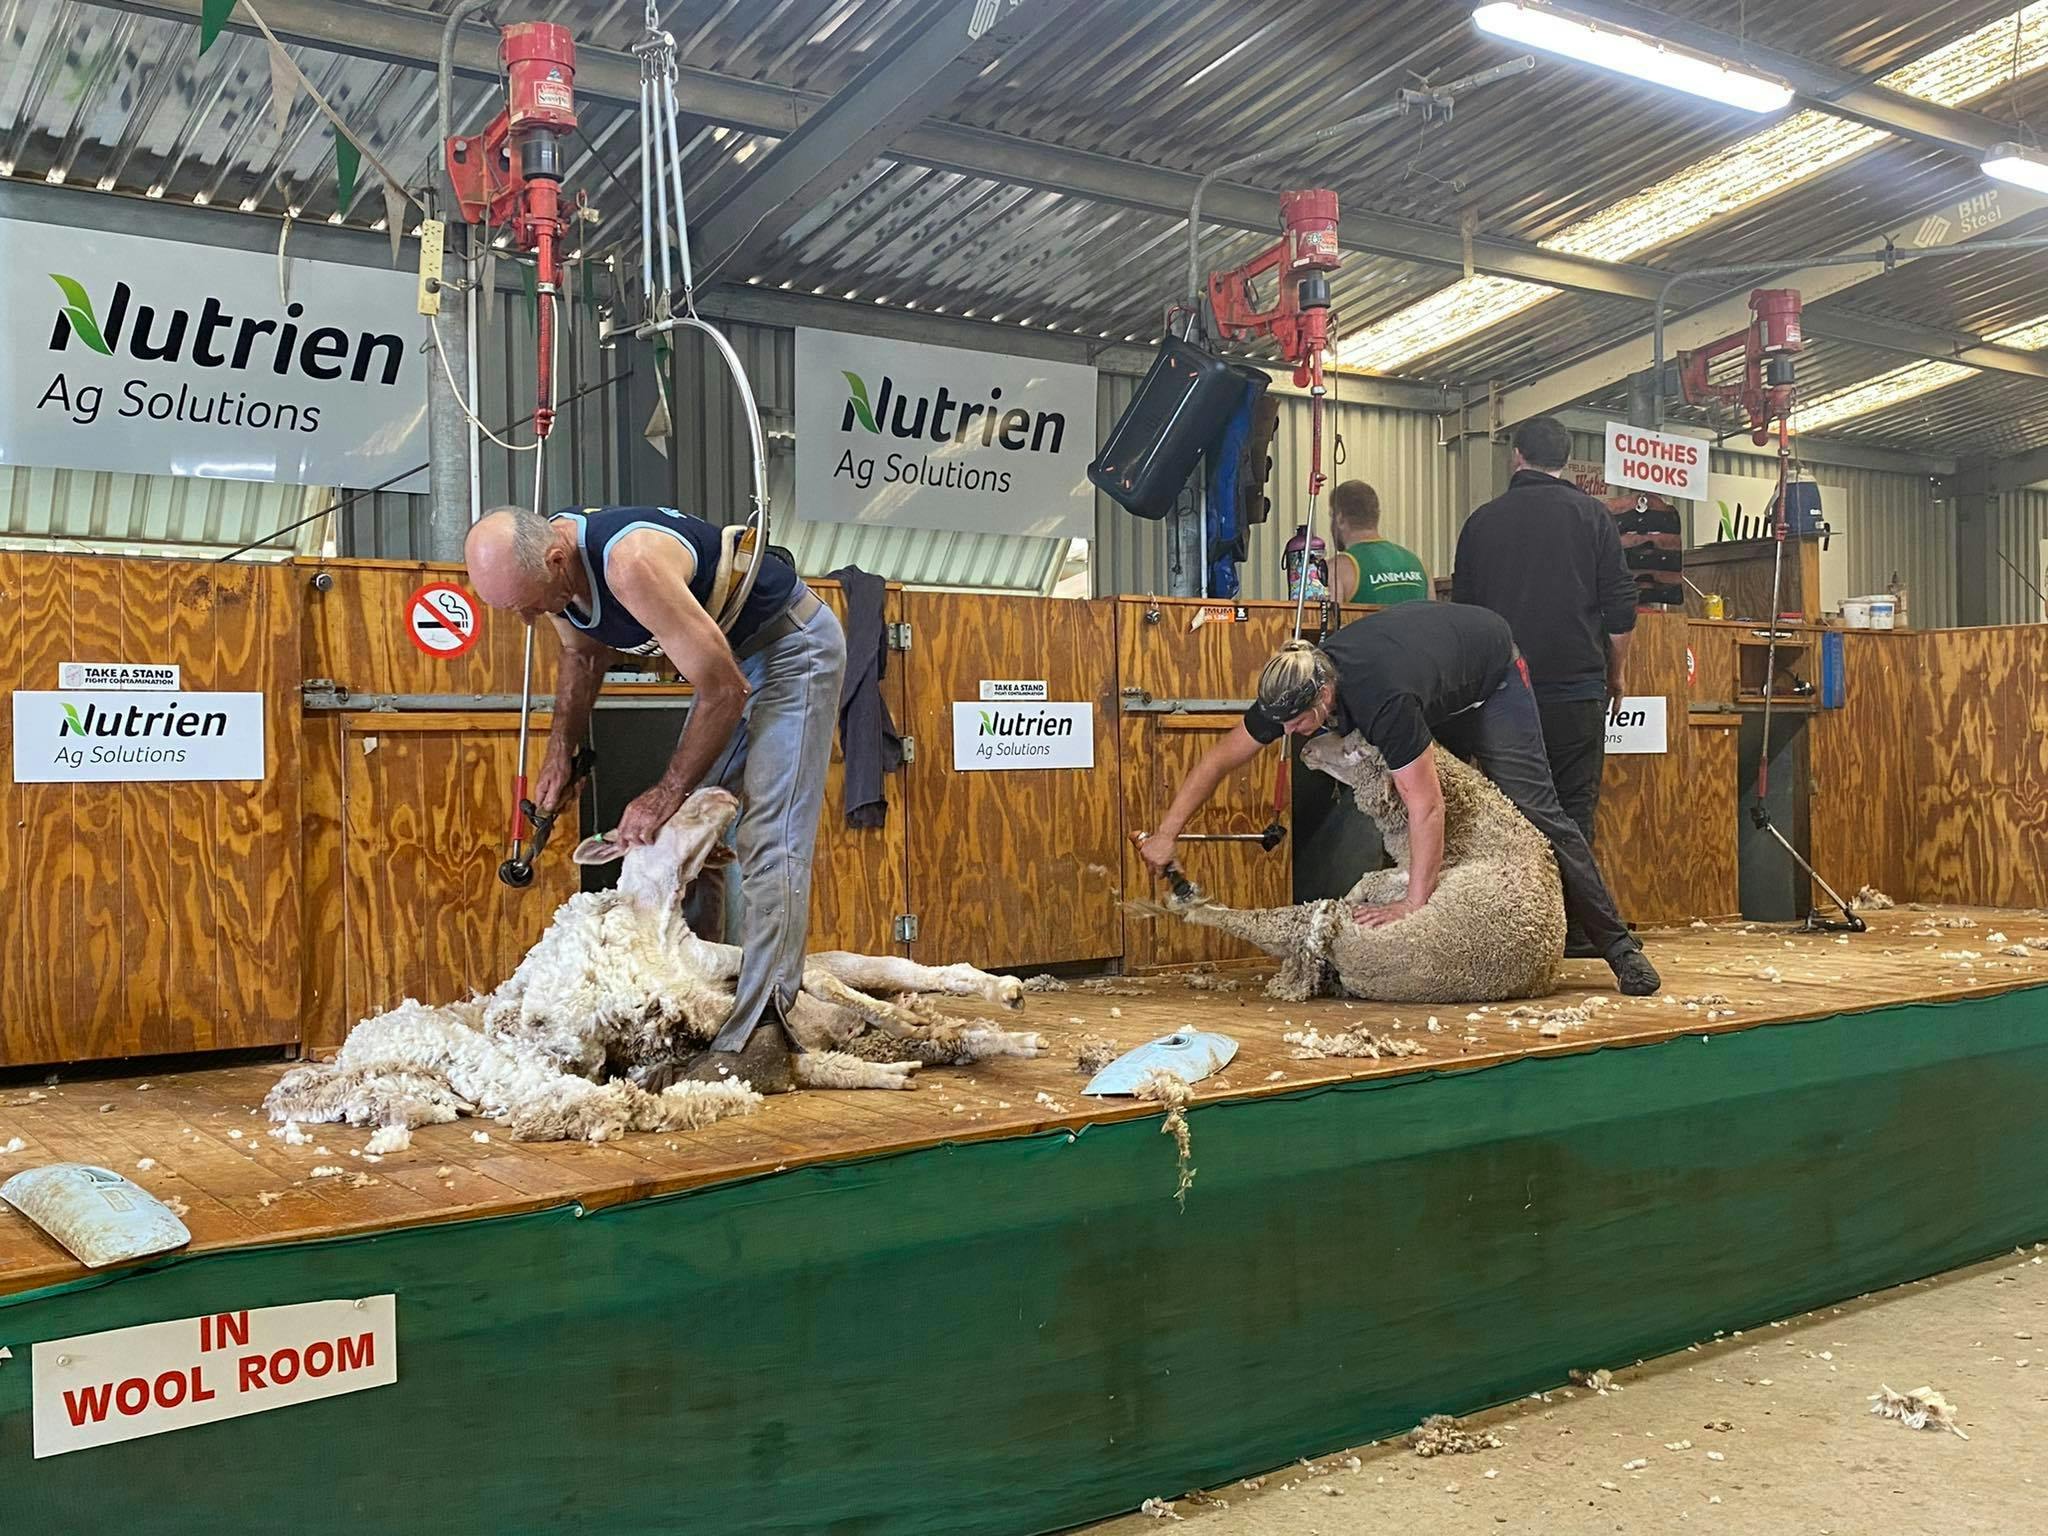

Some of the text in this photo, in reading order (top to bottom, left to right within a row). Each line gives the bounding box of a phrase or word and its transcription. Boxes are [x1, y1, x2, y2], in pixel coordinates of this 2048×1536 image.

[1959, 190, 1998, 219] BHP
[1961, 205, 2002, 233] Steel
[49, 273, 404, 386] Nutrien
[37, 373, 321, 433] Ag Solutions
[840, 370, 1066, 454] Nutrien
[1614, 433, 1698, 466] CLOTHES
[833, 448, 1012, 493] Ag Solutions
[1622, 458, 1688, 488] HOOKS
[1369, 571, 1424, 584] LANDMARK
[84, 677, 174, 685] FIGHT CONTAMINATION
[85, 668, 174, 679] TAKE A STAND
[59, 702, 228, 737] Nutrien
[978, 710, 1073, 737] Nutrien
[54, 745, 187, 769] Ag Solutions
[976, 742, 1051, 760] Ag Solutions
[199, 1311, 250, 1353] IN
[63, 1332, 375, 1427] WOOL ROOM
